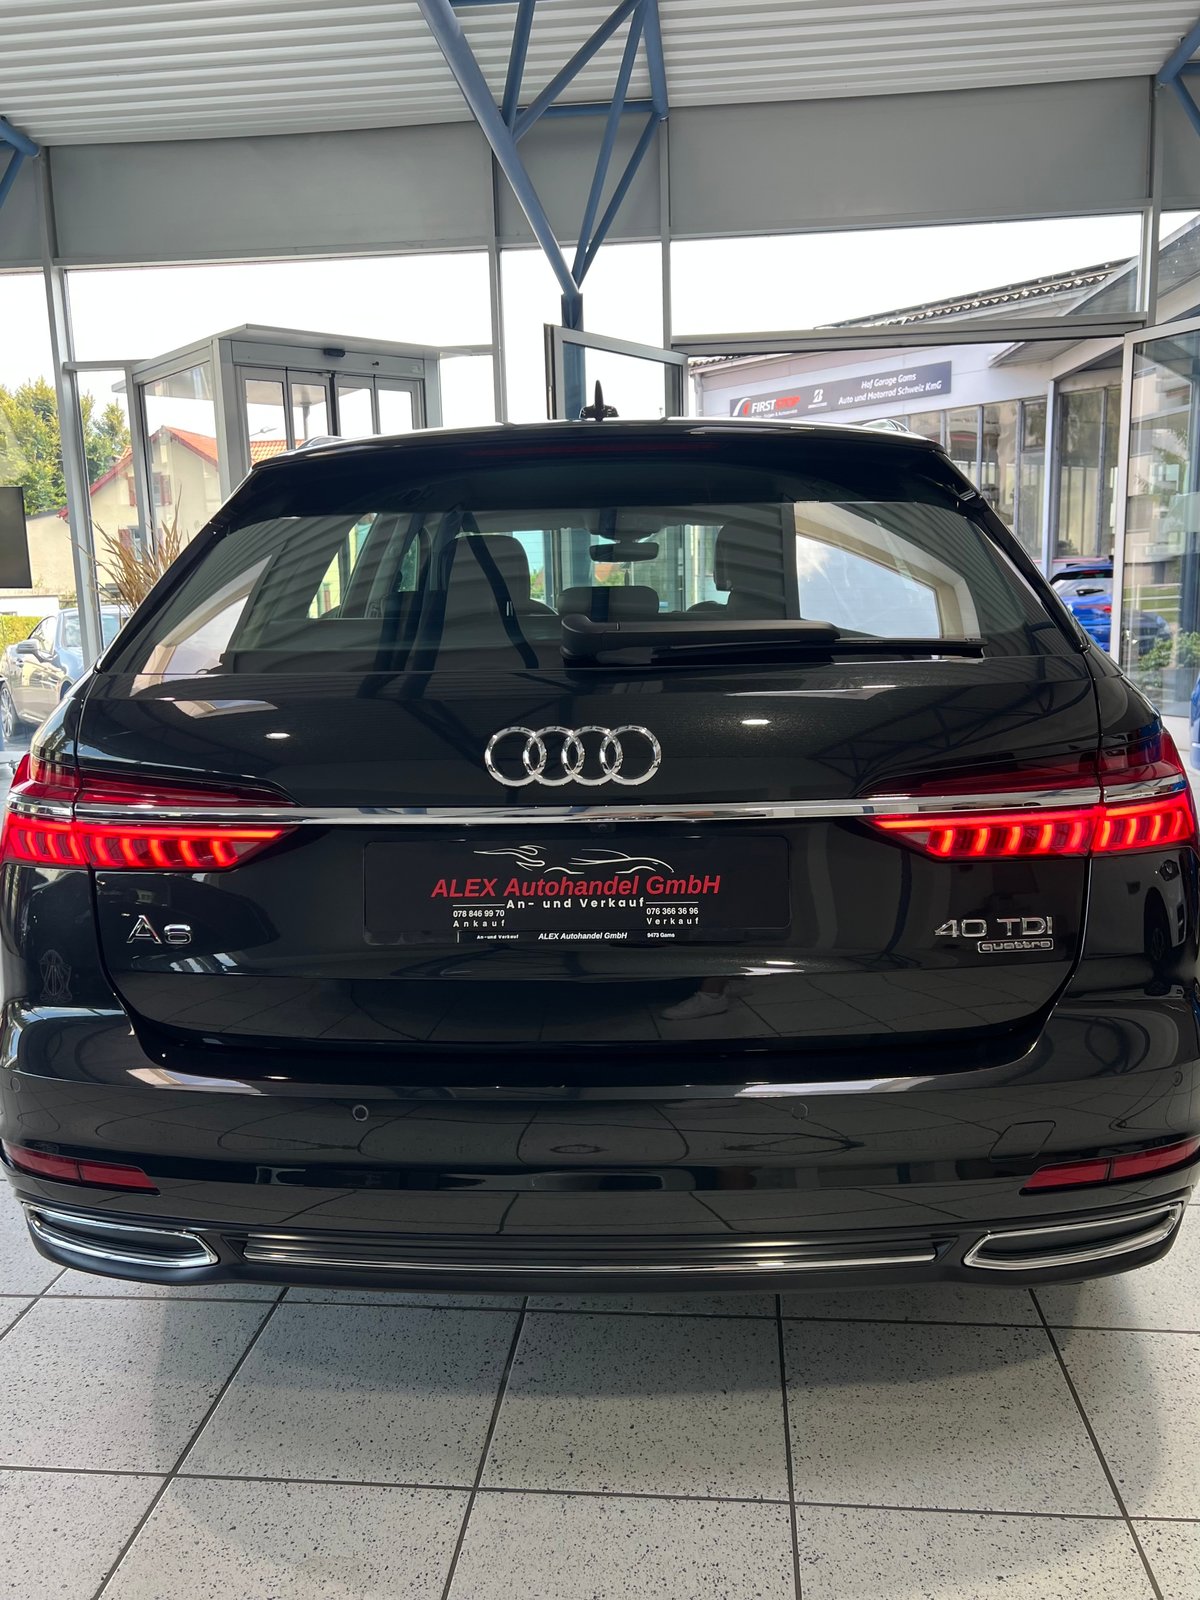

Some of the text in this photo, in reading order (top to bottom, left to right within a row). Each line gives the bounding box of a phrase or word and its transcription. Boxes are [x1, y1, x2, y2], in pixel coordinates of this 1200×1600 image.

[838, 396, 853, 404] Auto
[854, 394, 866, 402] und
[867, 388, 896, 400] Motorrad
[431, 875, 720, 898] ALEX Autohandel GmbH
[506, 898, 644, 909] An- und Verkauf
[453, 910, 467, 918] 078
[452, 920, 506, 928] Ankauf
[646, 917, 698, 925] Verkauf
[126, 914, 192, 944] A6
[935, 916, 1053, 938] 40 TDI
[538, 932, 628, 940] ALEX Autohandel GmbH
[981, 940, 1051, 952] quattro
